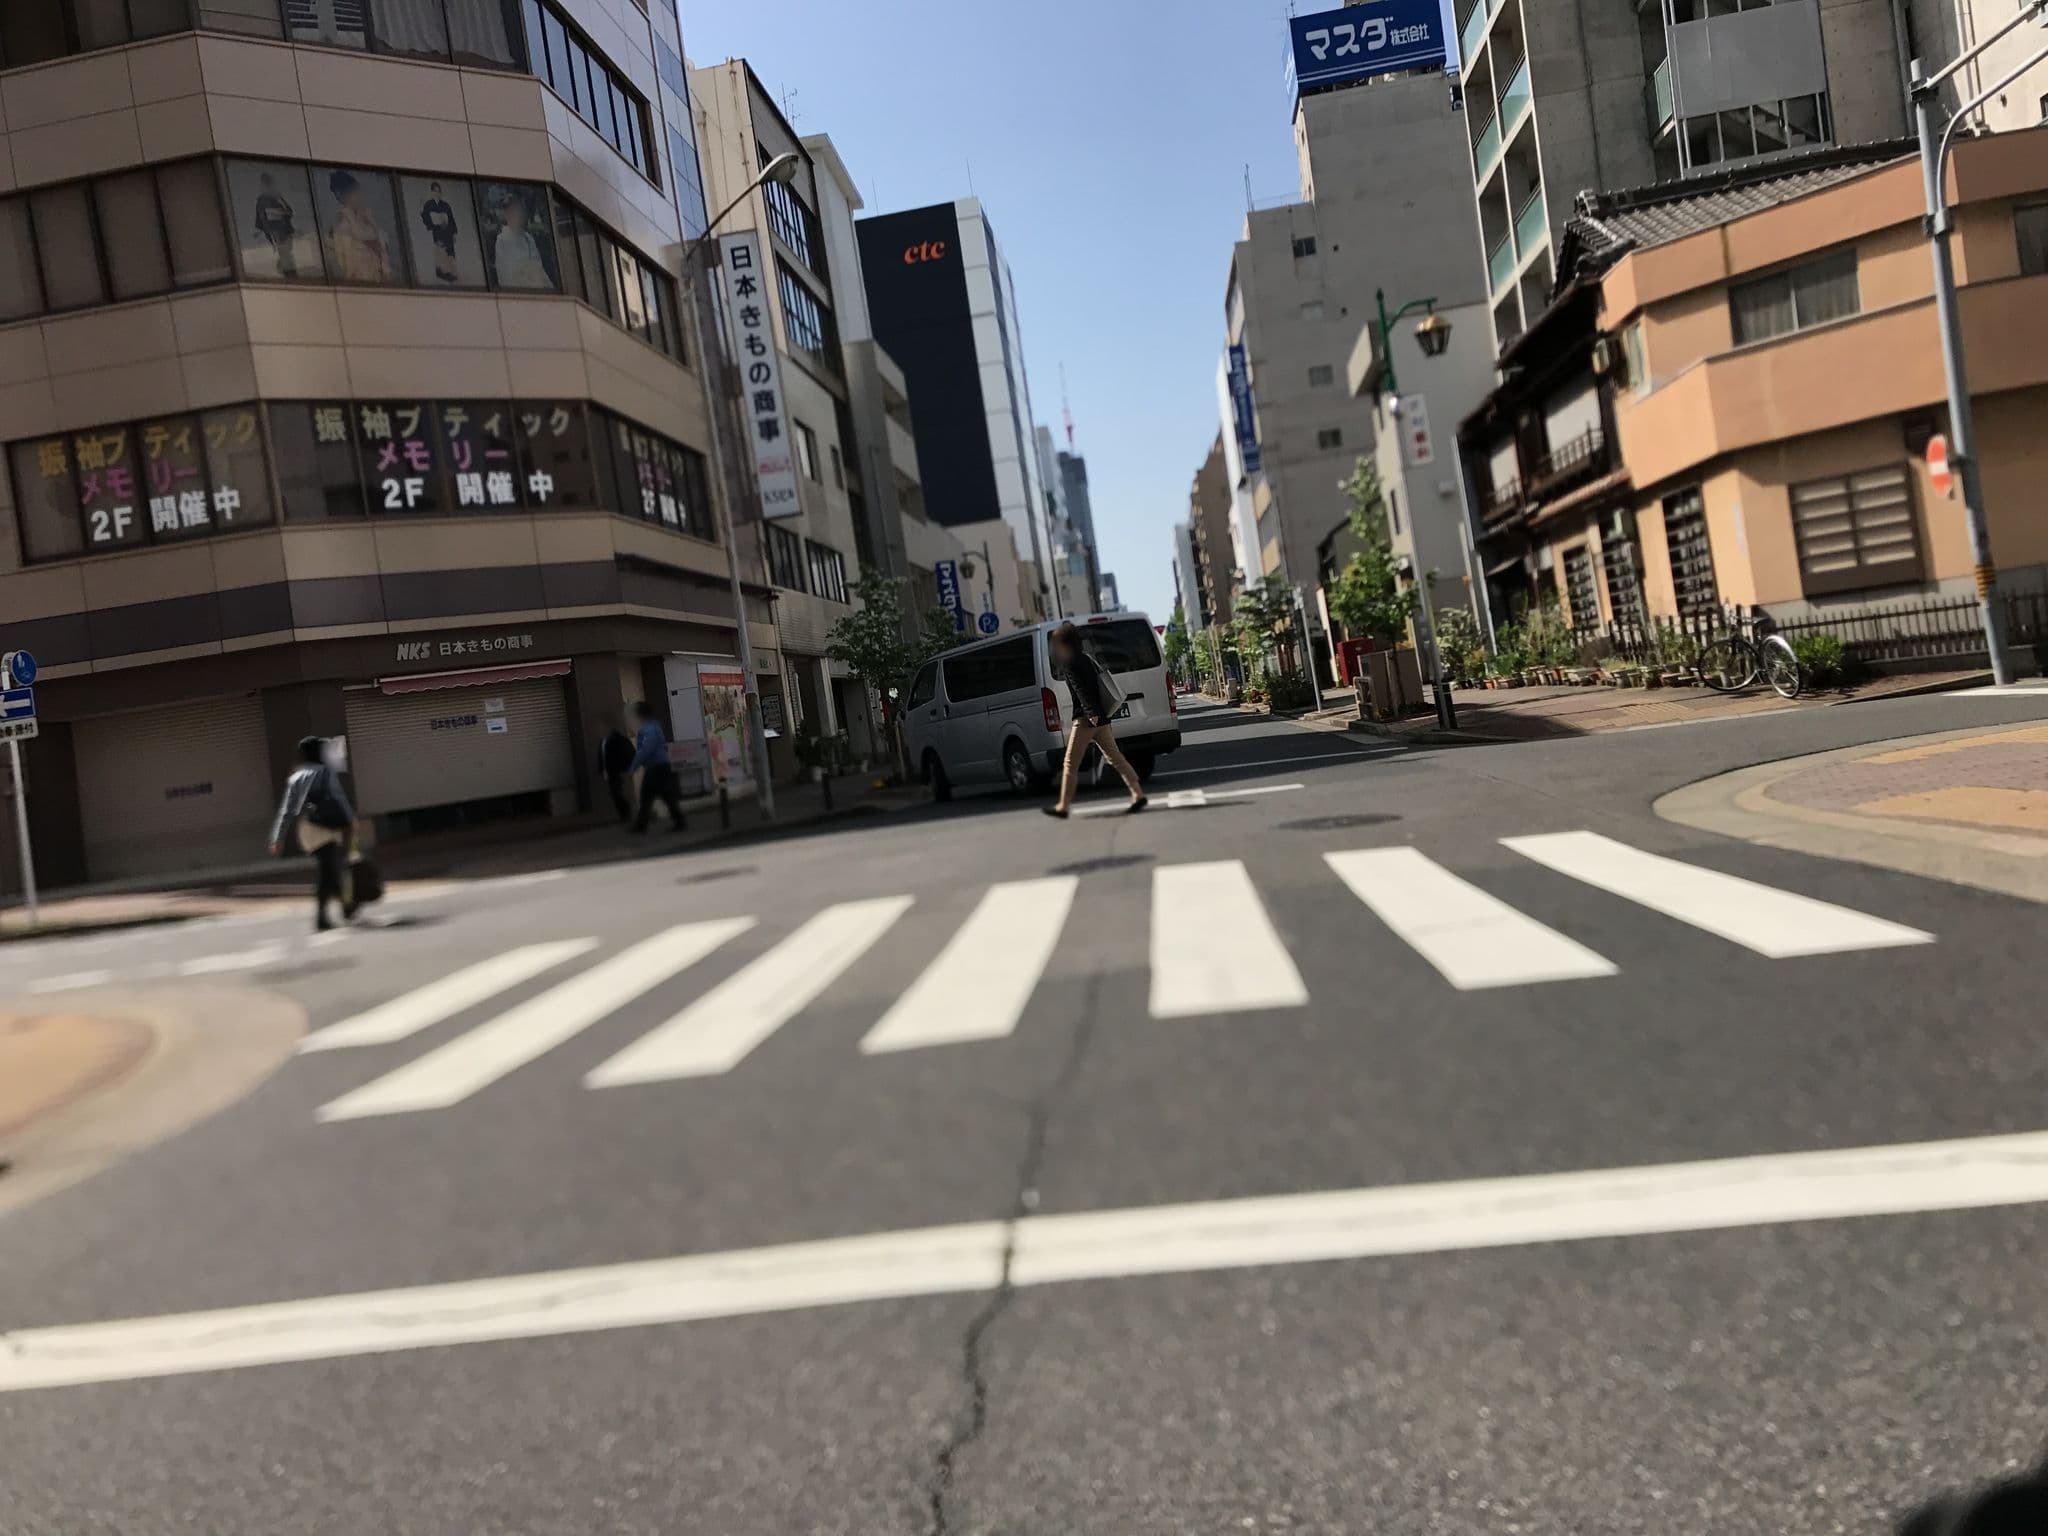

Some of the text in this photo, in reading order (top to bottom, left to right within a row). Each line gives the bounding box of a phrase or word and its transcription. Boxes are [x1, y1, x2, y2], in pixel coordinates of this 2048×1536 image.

[903, 240, 945, 265] ctc
[730, 245, 780, 443] 日本きもの商事
[376, 440, 508, 472] メモリー
[381, 469, 554, 508] 2F 開催中
[91, 484, 241, 542] 2F 開催中
[397, 634, 534, 661] NKS 日本きもの商事
